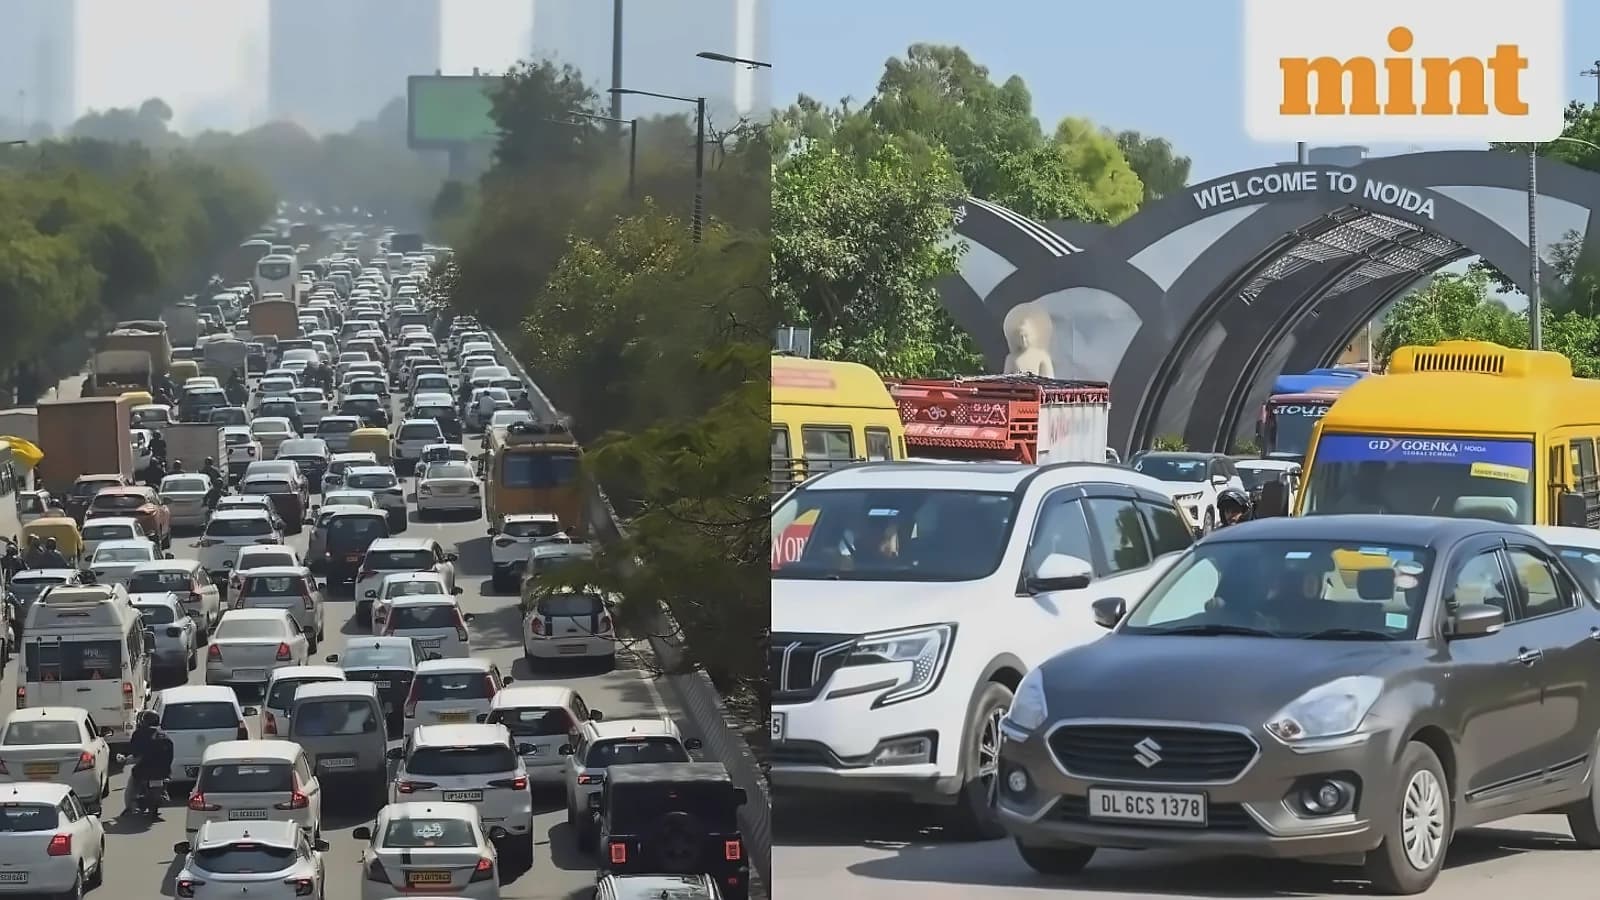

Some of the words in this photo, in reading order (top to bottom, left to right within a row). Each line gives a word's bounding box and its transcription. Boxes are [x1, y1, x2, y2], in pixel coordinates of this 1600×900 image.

[1193, 171, 1318, 211] WELCOME
[1326, 171, 1357, 194] TO
[1363, 179, 1435, 220] NOIDA
[1401, 440, 1459, 453] GOENKA
[1101, 794, 1122, 813] DL
[1125, 795, 1155, 815] 6CS
[1160, 797, 1200, 817] 1378
